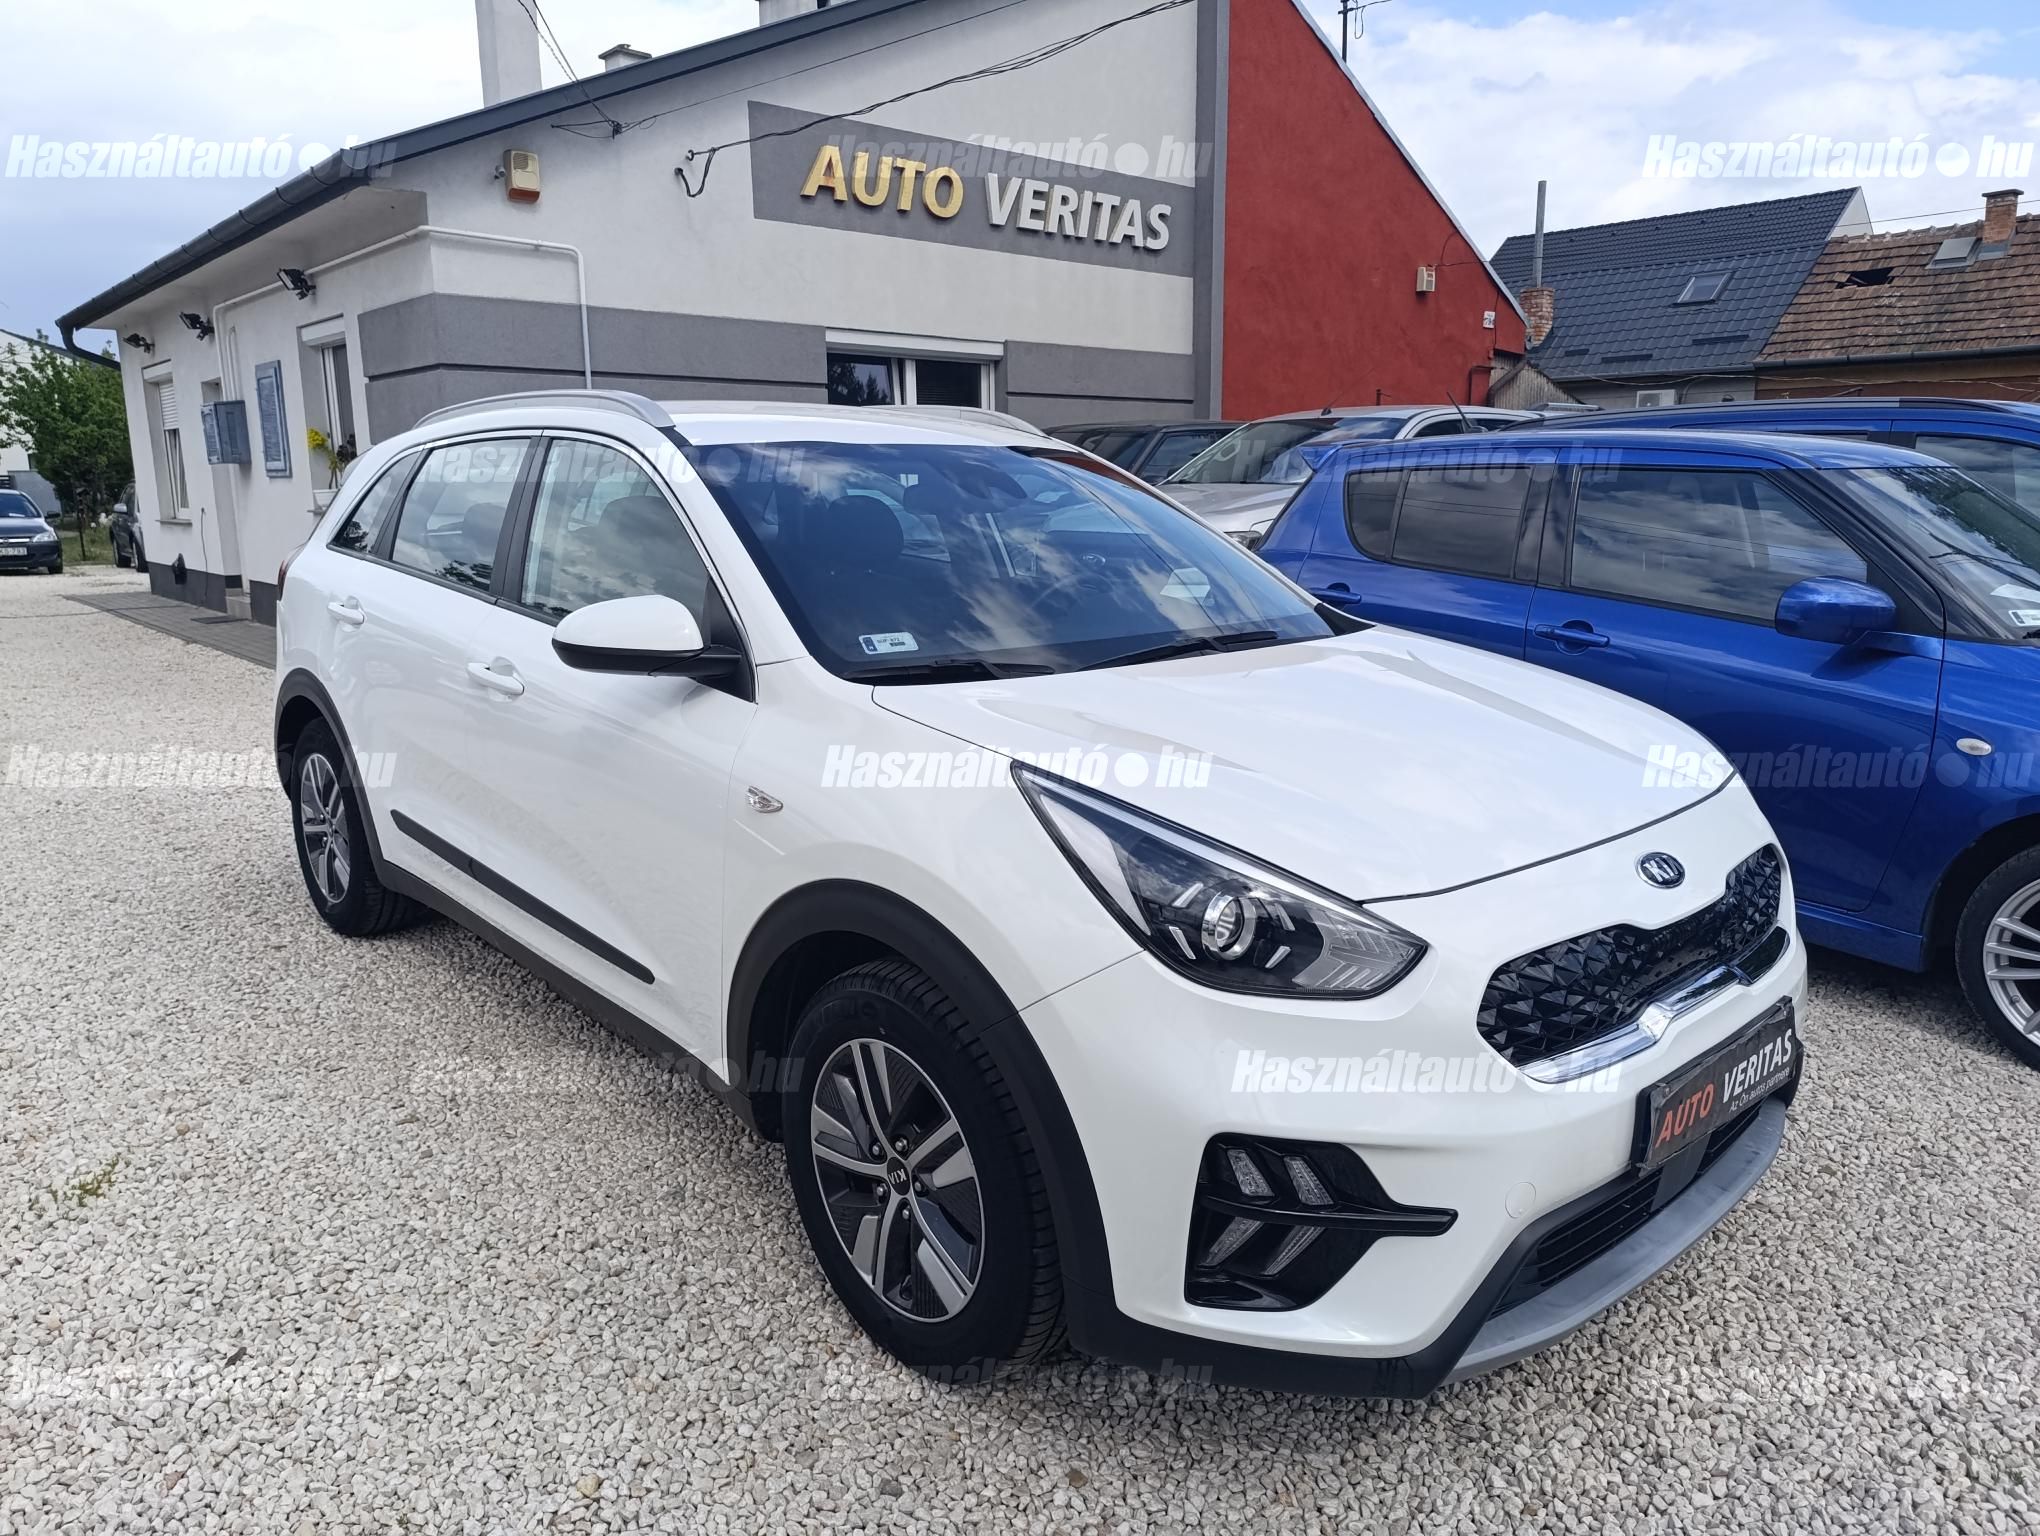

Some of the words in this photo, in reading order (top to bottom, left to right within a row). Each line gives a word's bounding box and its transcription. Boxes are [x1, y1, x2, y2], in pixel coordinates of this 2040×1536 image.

[800, 144, 964, 219] AUTO
[985, 172, 1172, 250] VERITAS
[1655, 1083, 1715, 1149] AUTO
[1722, 1028, 1793, 1104] VERITAS
[888, 1169, 907, 1184] KIA
